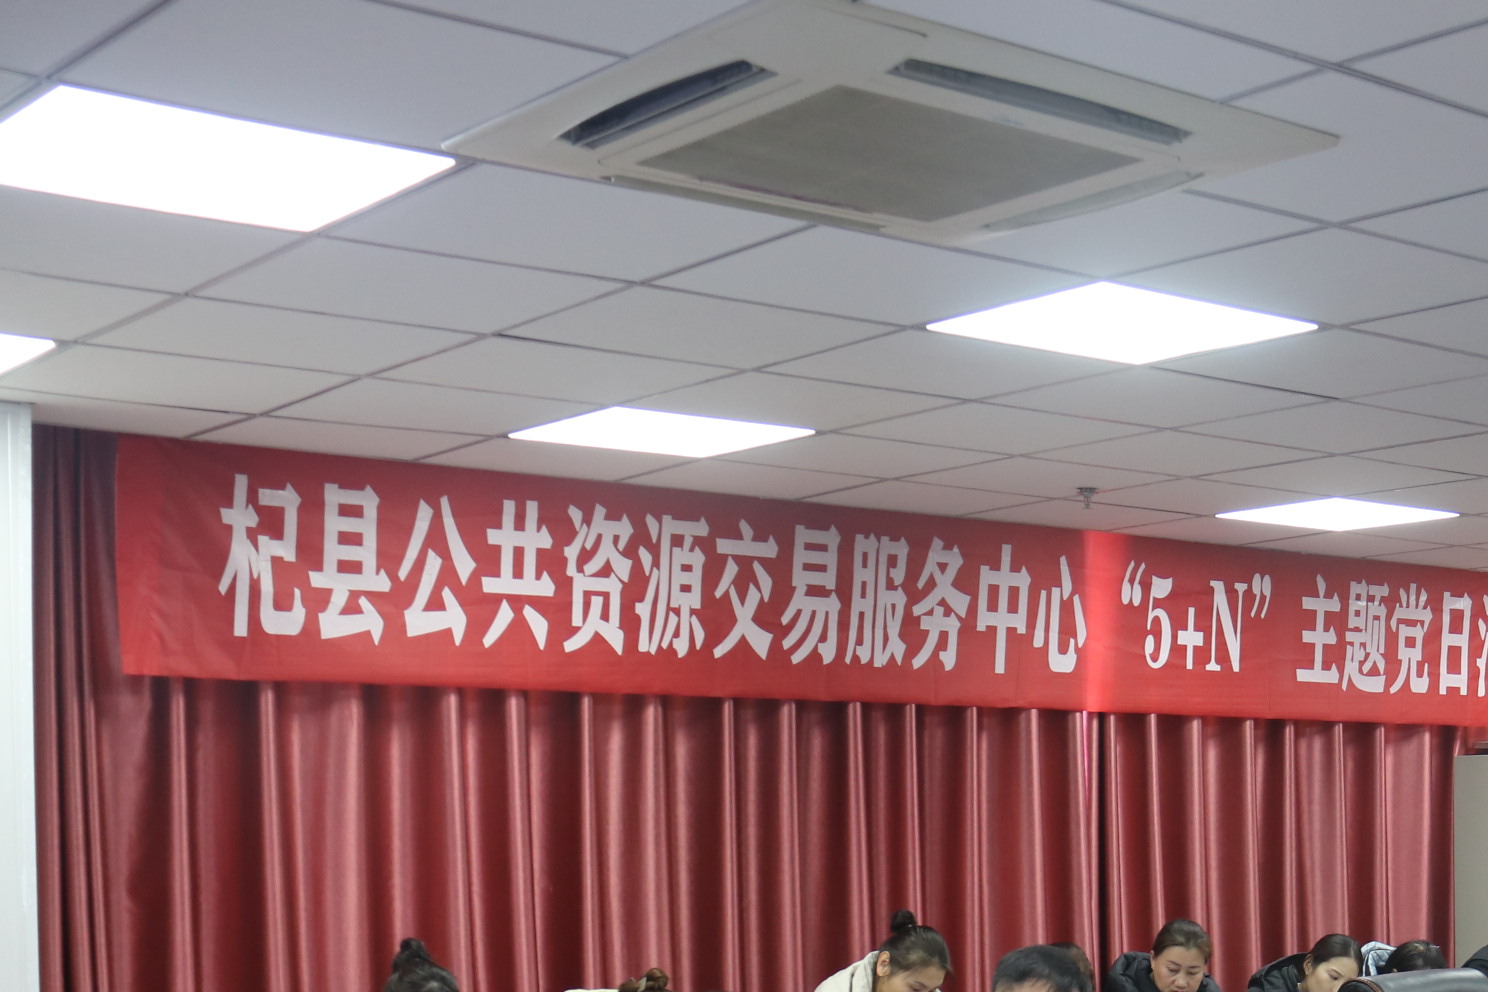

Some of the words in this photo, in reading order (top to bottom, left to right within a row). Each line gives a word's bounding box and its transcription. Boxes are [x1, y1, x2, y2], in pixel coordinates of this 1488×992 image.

[218, 473, 1087, 674] 杞县公共资源交易服务中心
